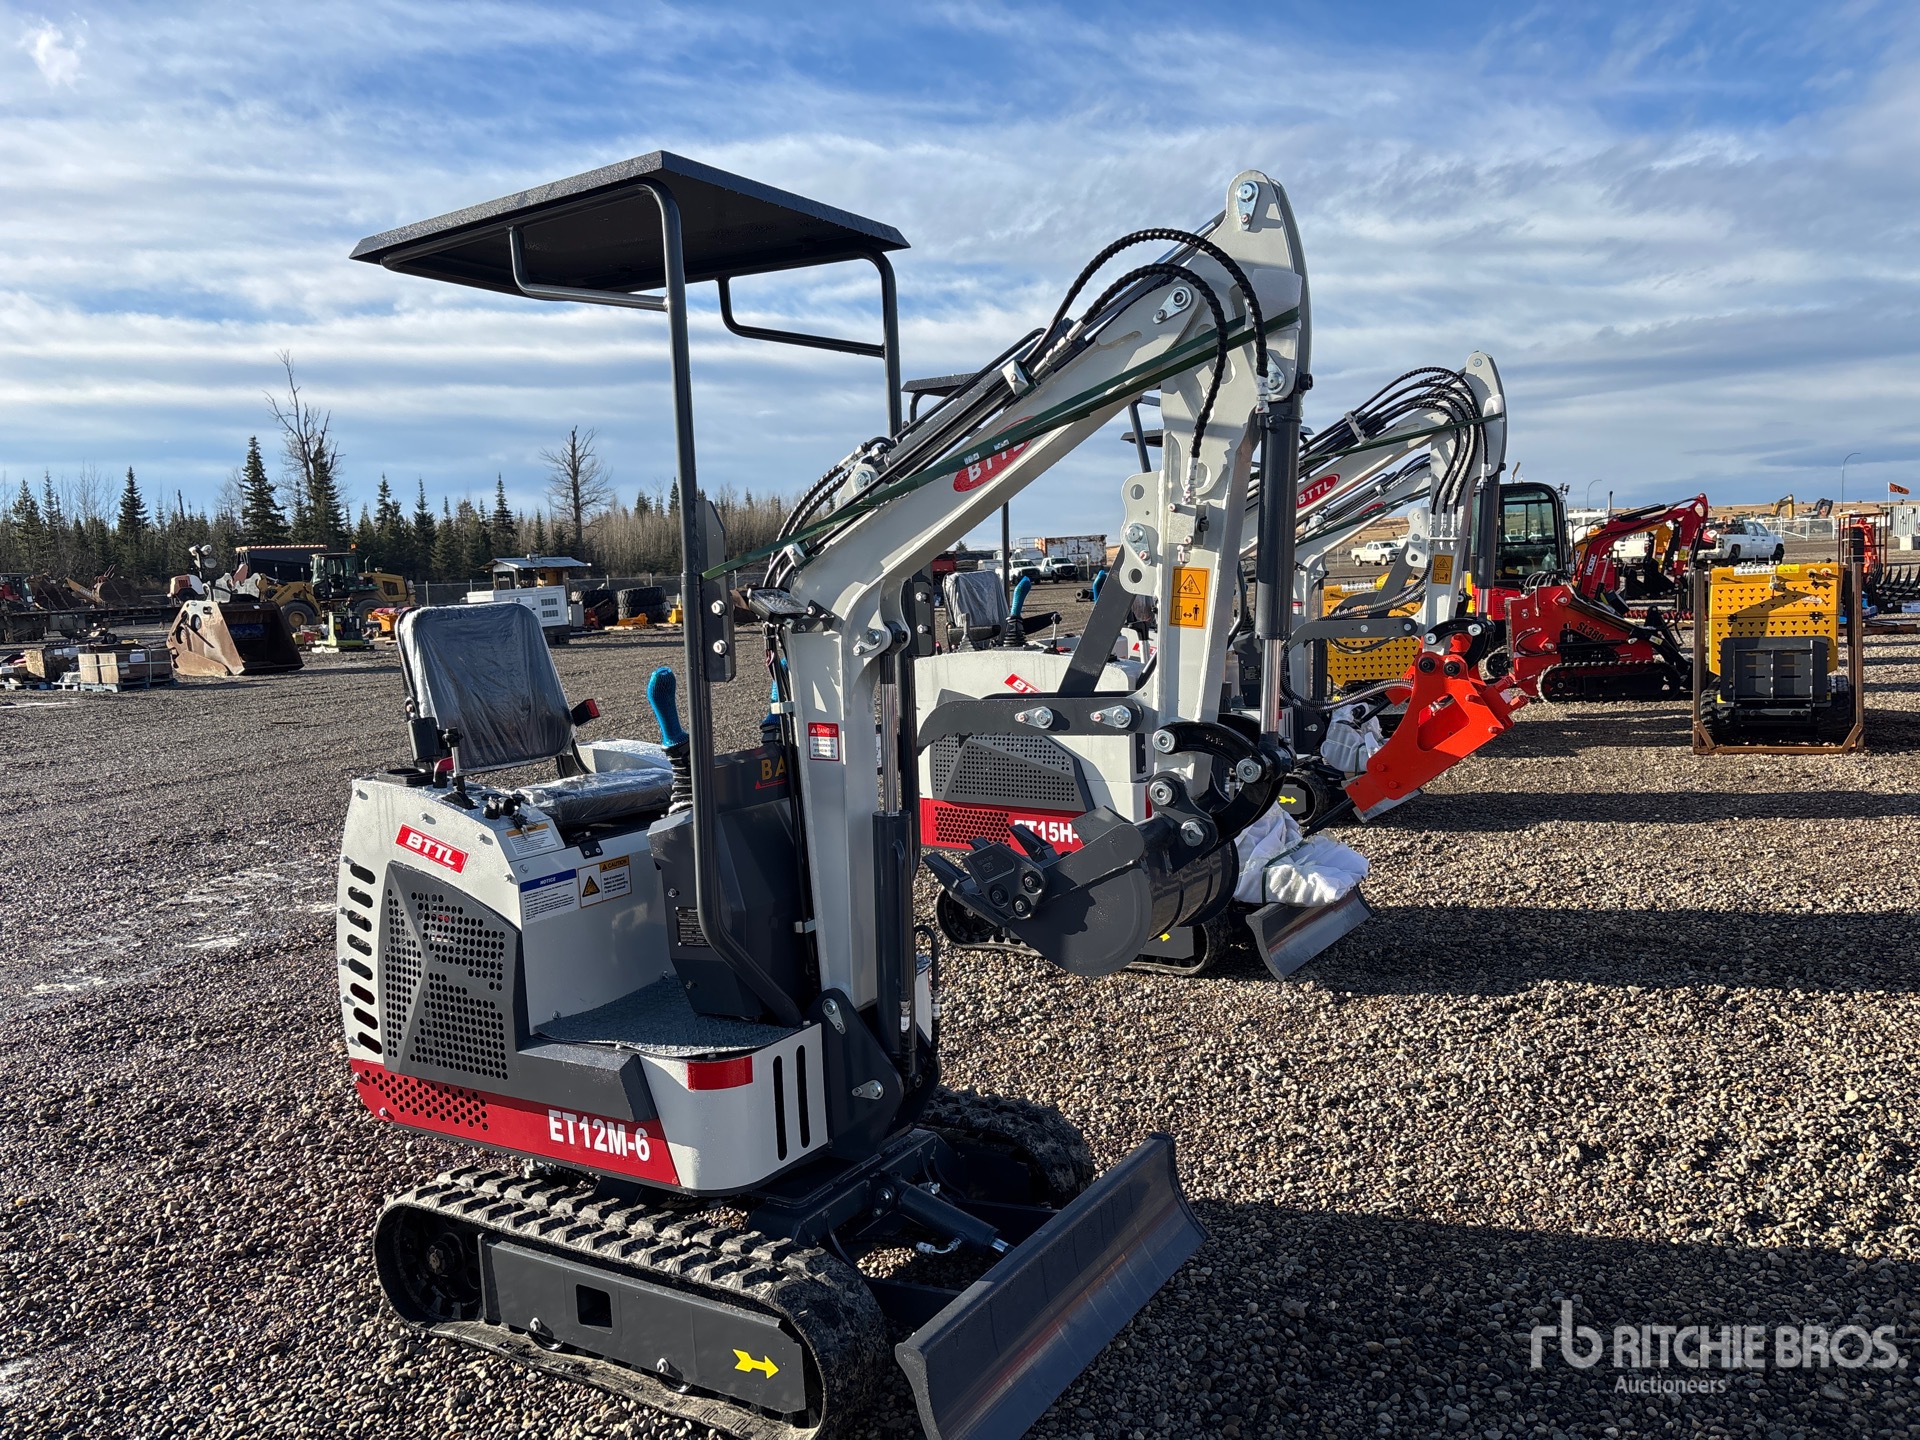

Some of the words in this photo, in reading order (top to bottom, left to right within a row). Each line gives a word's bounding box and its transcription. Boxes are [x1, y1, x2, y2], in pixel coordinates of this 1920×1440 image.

[1297, 481, 1332, 505] BTTL
[817, 726, 837, 734] DANGER
[405, 831, 456, 866] BTTL
[607, 859, 628, 869] CAUTION
[539, 876, 557, 886] NOTICE
[548, 1108, 651, 1162] ET12M-6
